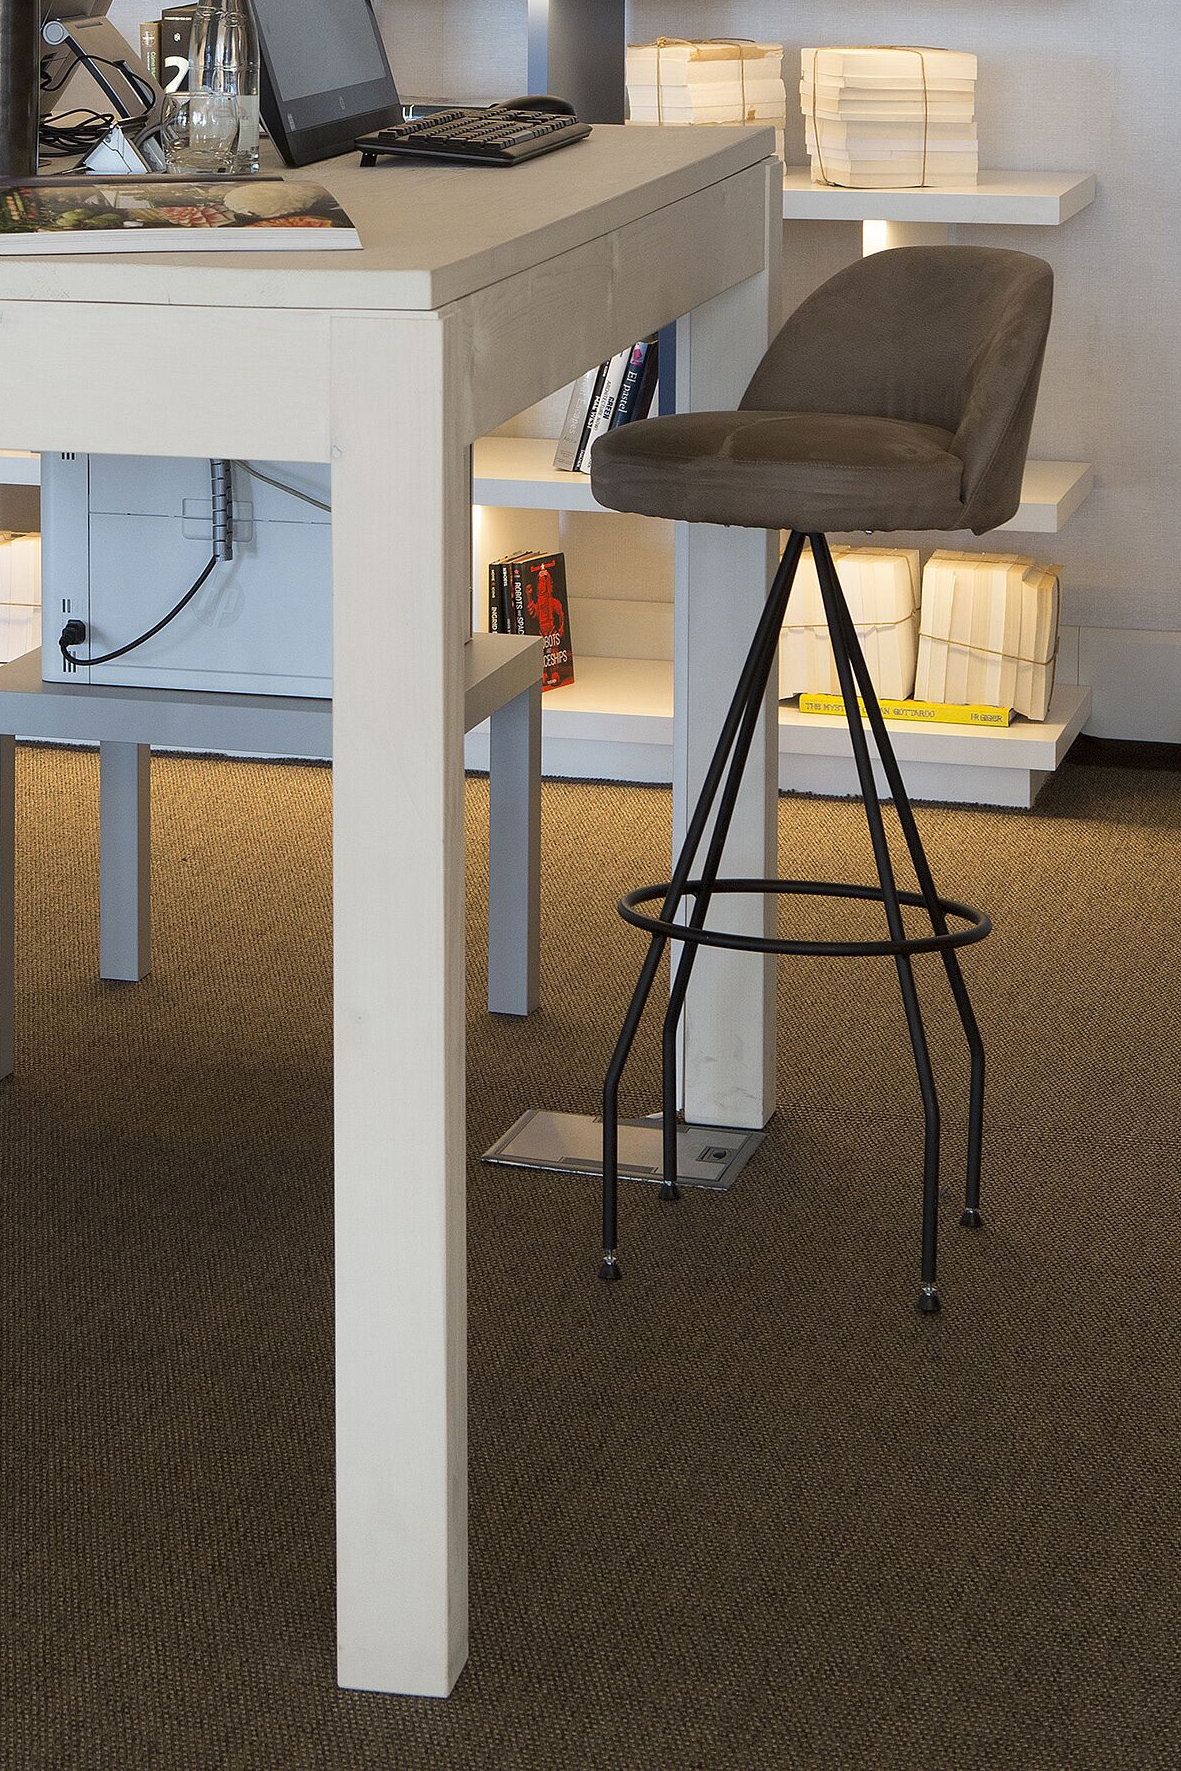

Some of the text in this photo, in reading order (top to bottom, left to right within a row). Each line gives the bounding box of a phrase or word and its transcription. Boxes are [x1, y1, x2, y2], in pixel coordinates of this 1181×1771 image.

[597, 380, 611, 416] ARCHITECTURE
[618, 370, 638, 414] El pastel
[602, 396, 615, 420] GREEN
[514, 582, 523, 610] ROBOTS
[805, 701, 821, 710] THE
[892, 708, 936, 718] GOTTARDO
